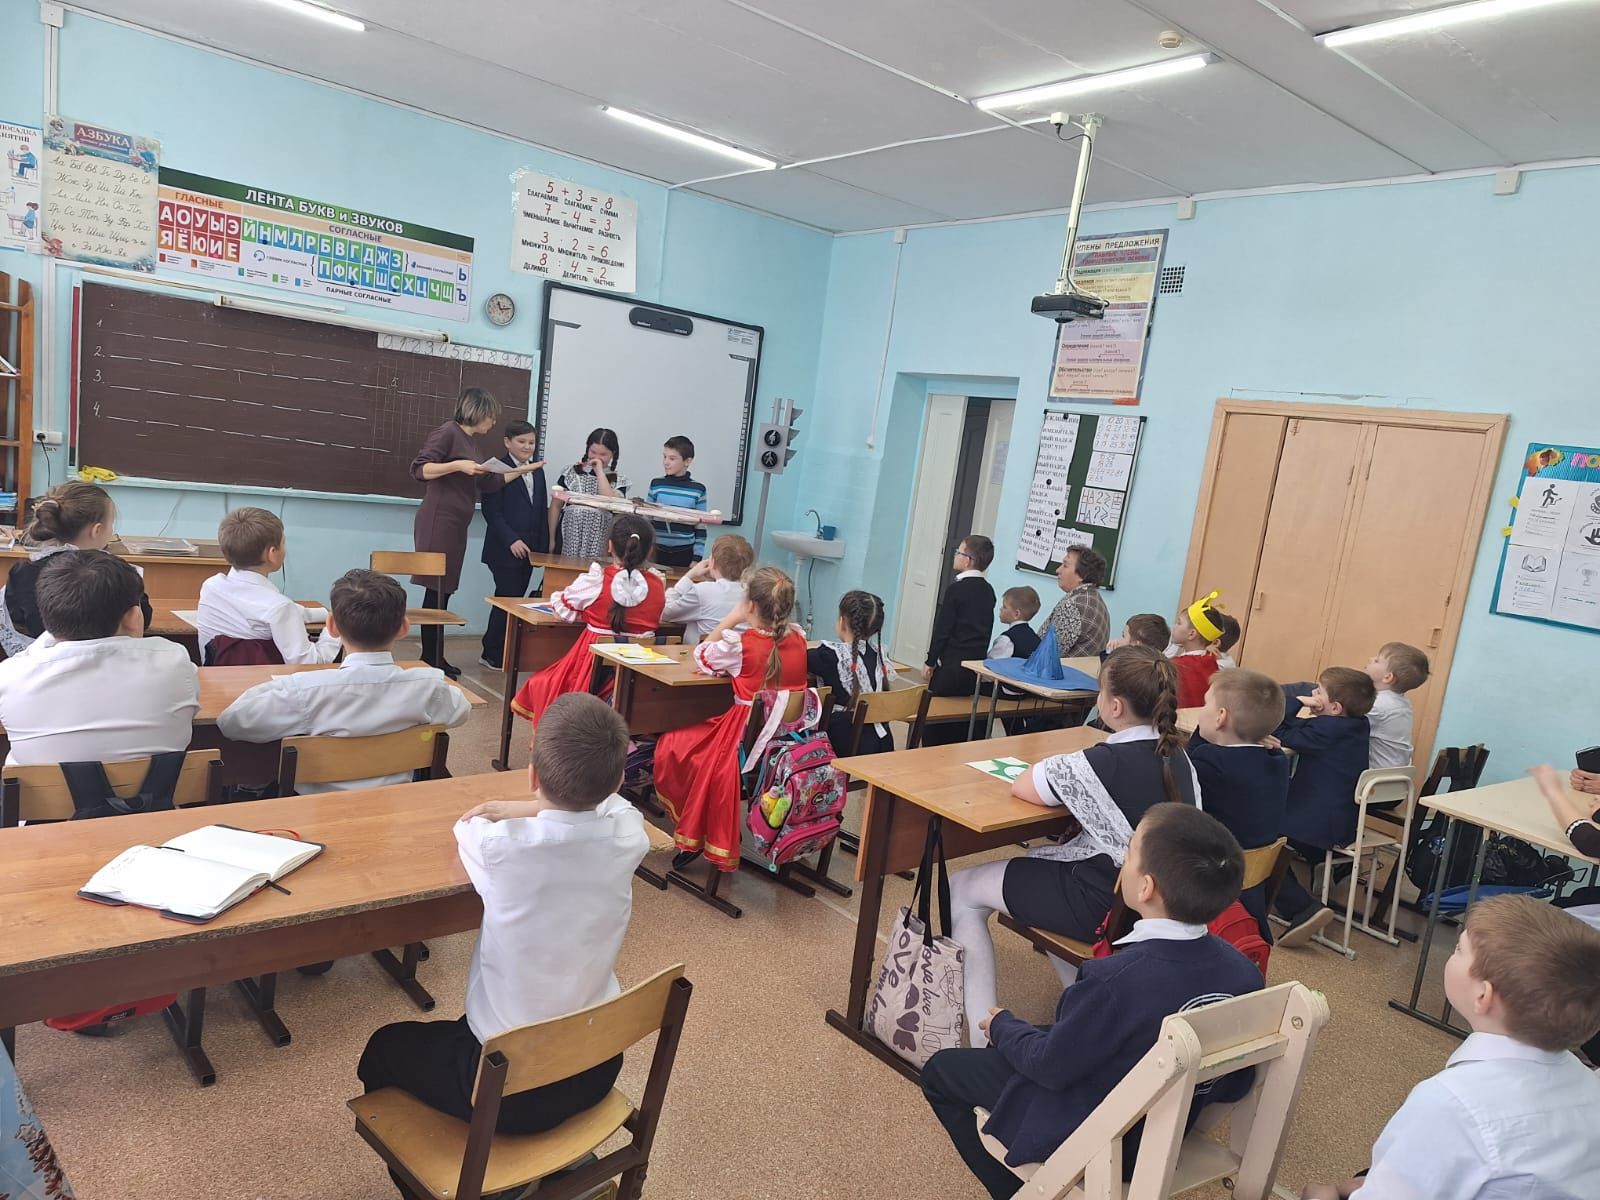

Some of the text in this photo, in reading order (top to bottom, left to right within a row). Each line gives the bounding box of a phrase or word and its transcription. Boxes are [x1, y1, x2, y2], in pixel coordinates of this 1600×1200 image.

[0, 132, 29, 143] НЯТИЙ
[77, 127, 130, 148] АЗБУКА
[175, 192, 224, 209] ГЛАСНЫЕ
[546, 181, 555, 194] 5
[575, 189, 583, 202] 3
[605, 197, 613, 210] 8
[245, 189, 404, 234] ЛЕНТА БУКВ и ЗВУКОВ
[544, 203, 552, 216] 7
[573, 211, 581, 224] 4
[604, 219, 611, 232] 3
[329, 225, 383, 243] СОГЛАСНЫЕ
[1105, 238, 1160, 249] ПРЕДЛОЖЕНИЯ
[541, 231, 549, 244] 3
[572, 238, 579, 251] 2
[601, 245, 609, 258] 6
[539, 253, 548, 266] 8
[571, 260, 579, 273] 4
[600, 267, 607, 279] 2
[326, 286, 392, 304] ПАРНЫЕ СОГЛАСНЫЕ
[1570, 452, 1600, 469] ПО
